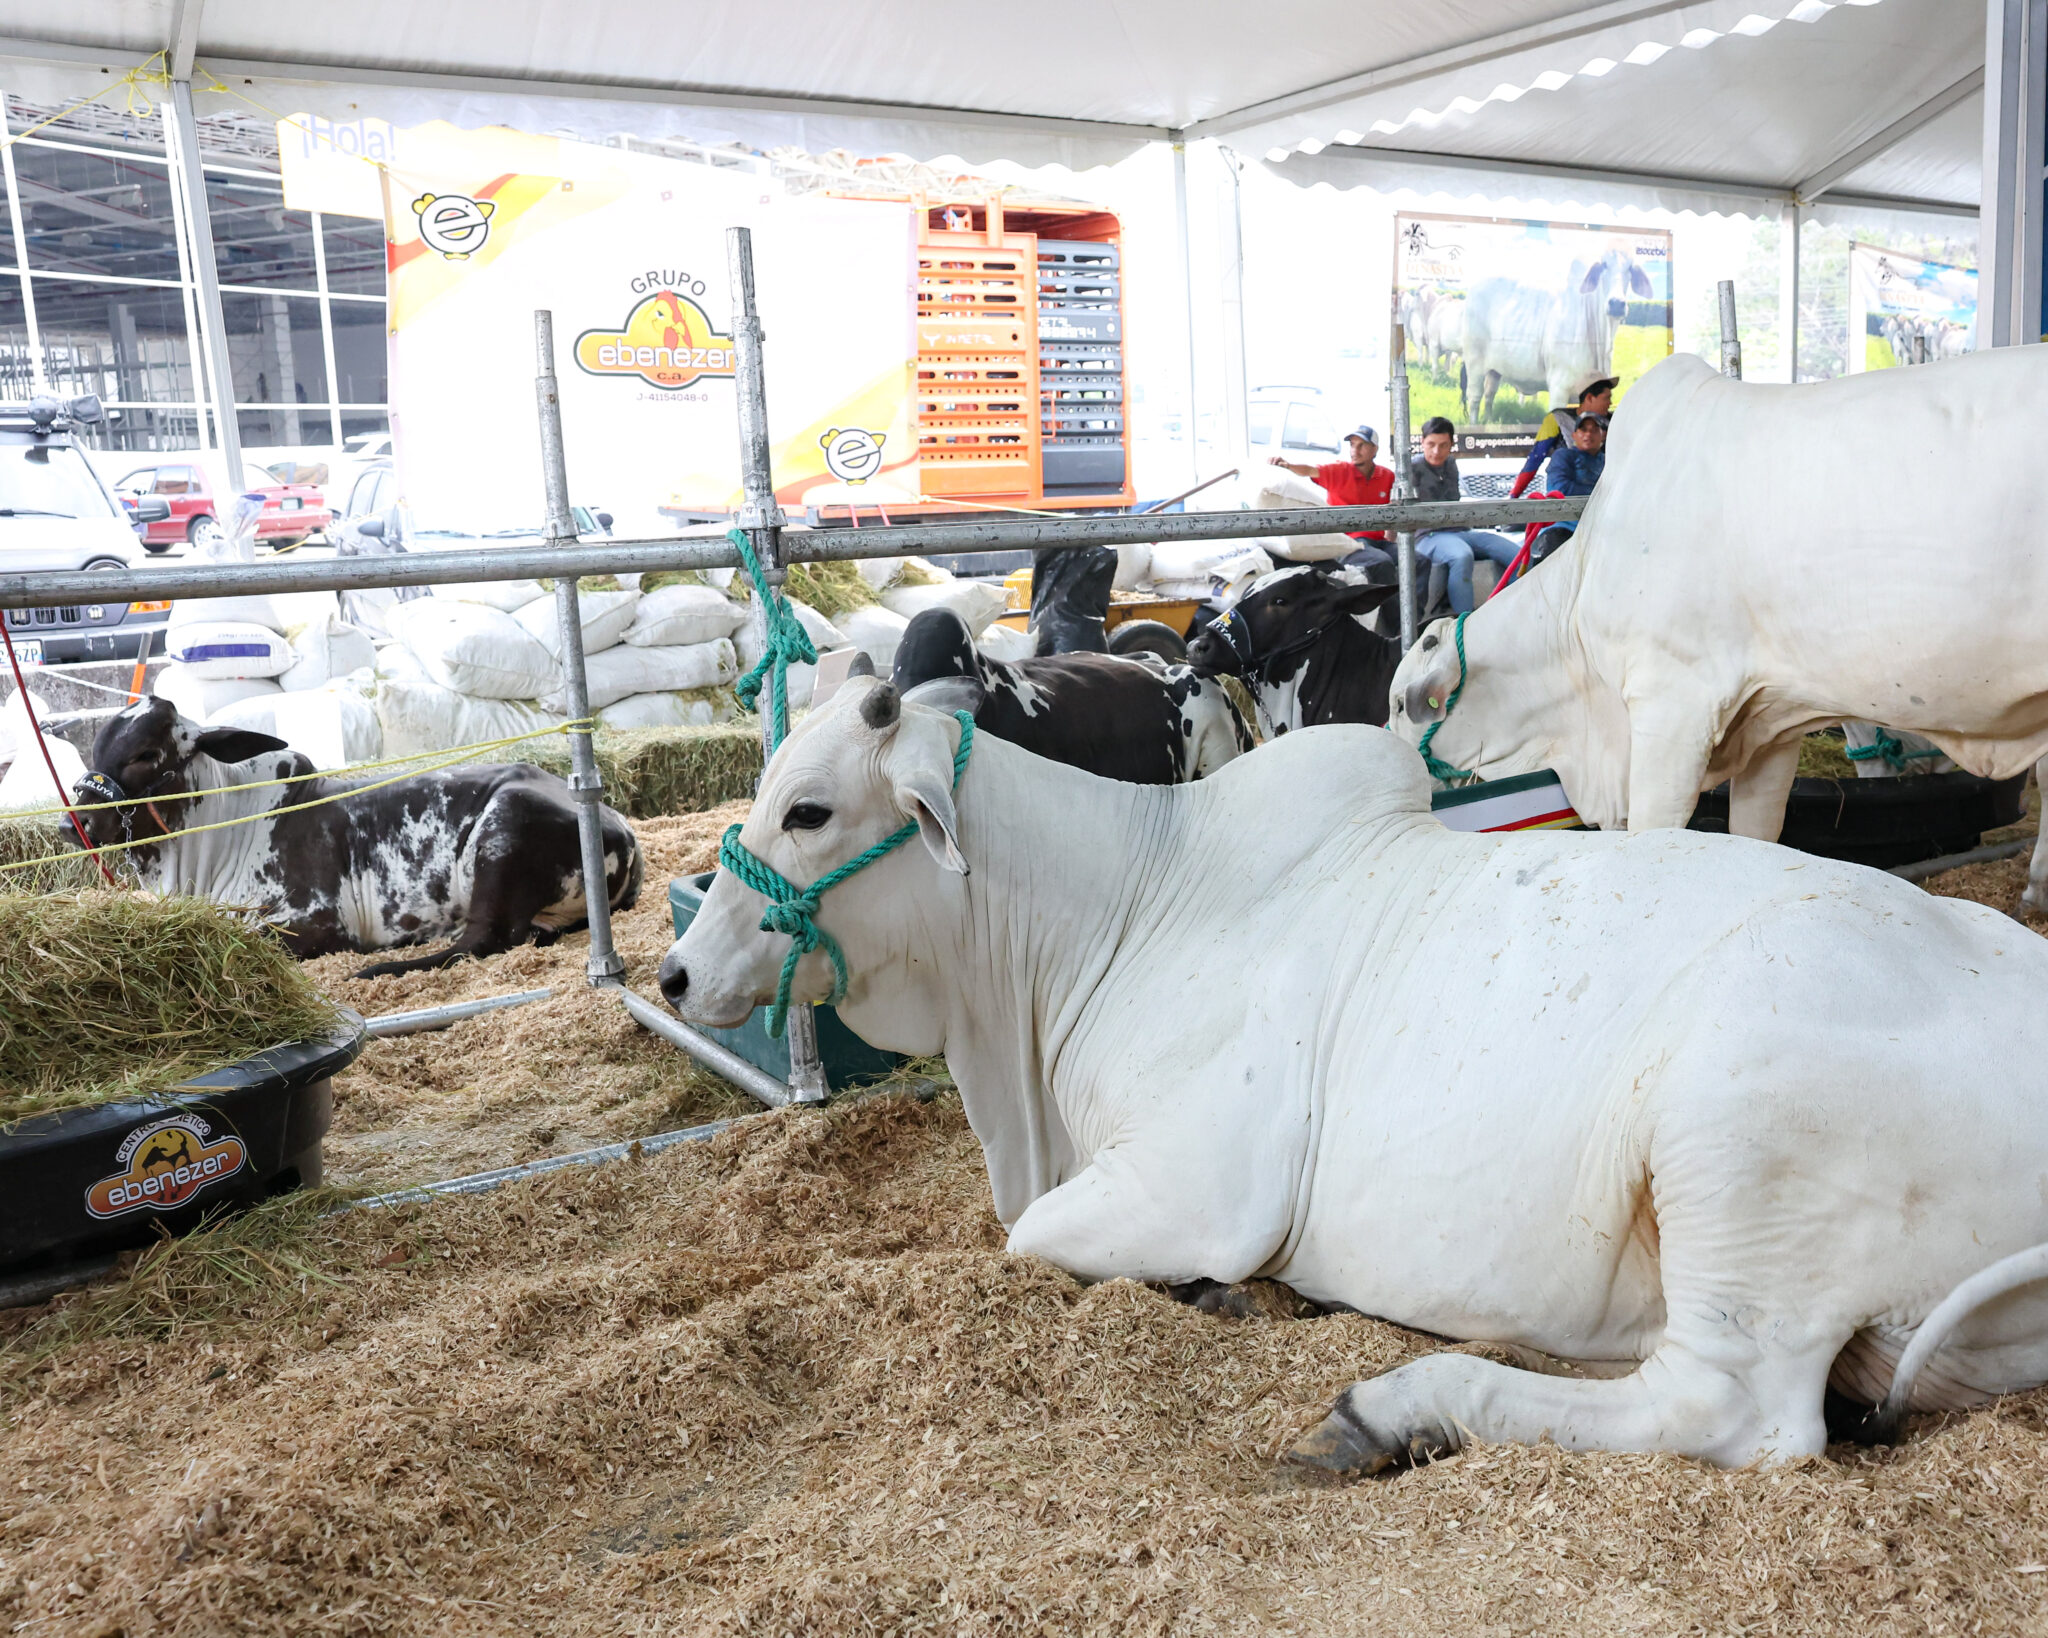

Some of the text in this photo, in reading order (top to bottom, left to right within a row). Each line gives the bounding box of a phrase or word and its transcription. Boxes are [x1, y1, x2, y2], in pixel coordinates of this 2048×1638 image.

[301, 114, 395, 161] ¡Hola!
[631, 269, 706, 296] GRUPO
[598, 338, 735, 368] ebenezer
[657, 372, 686, 380] c.a.
[636, 393, 709, 402] J-41154048-0
[108, 1152, 229, 1207] ebenezer
